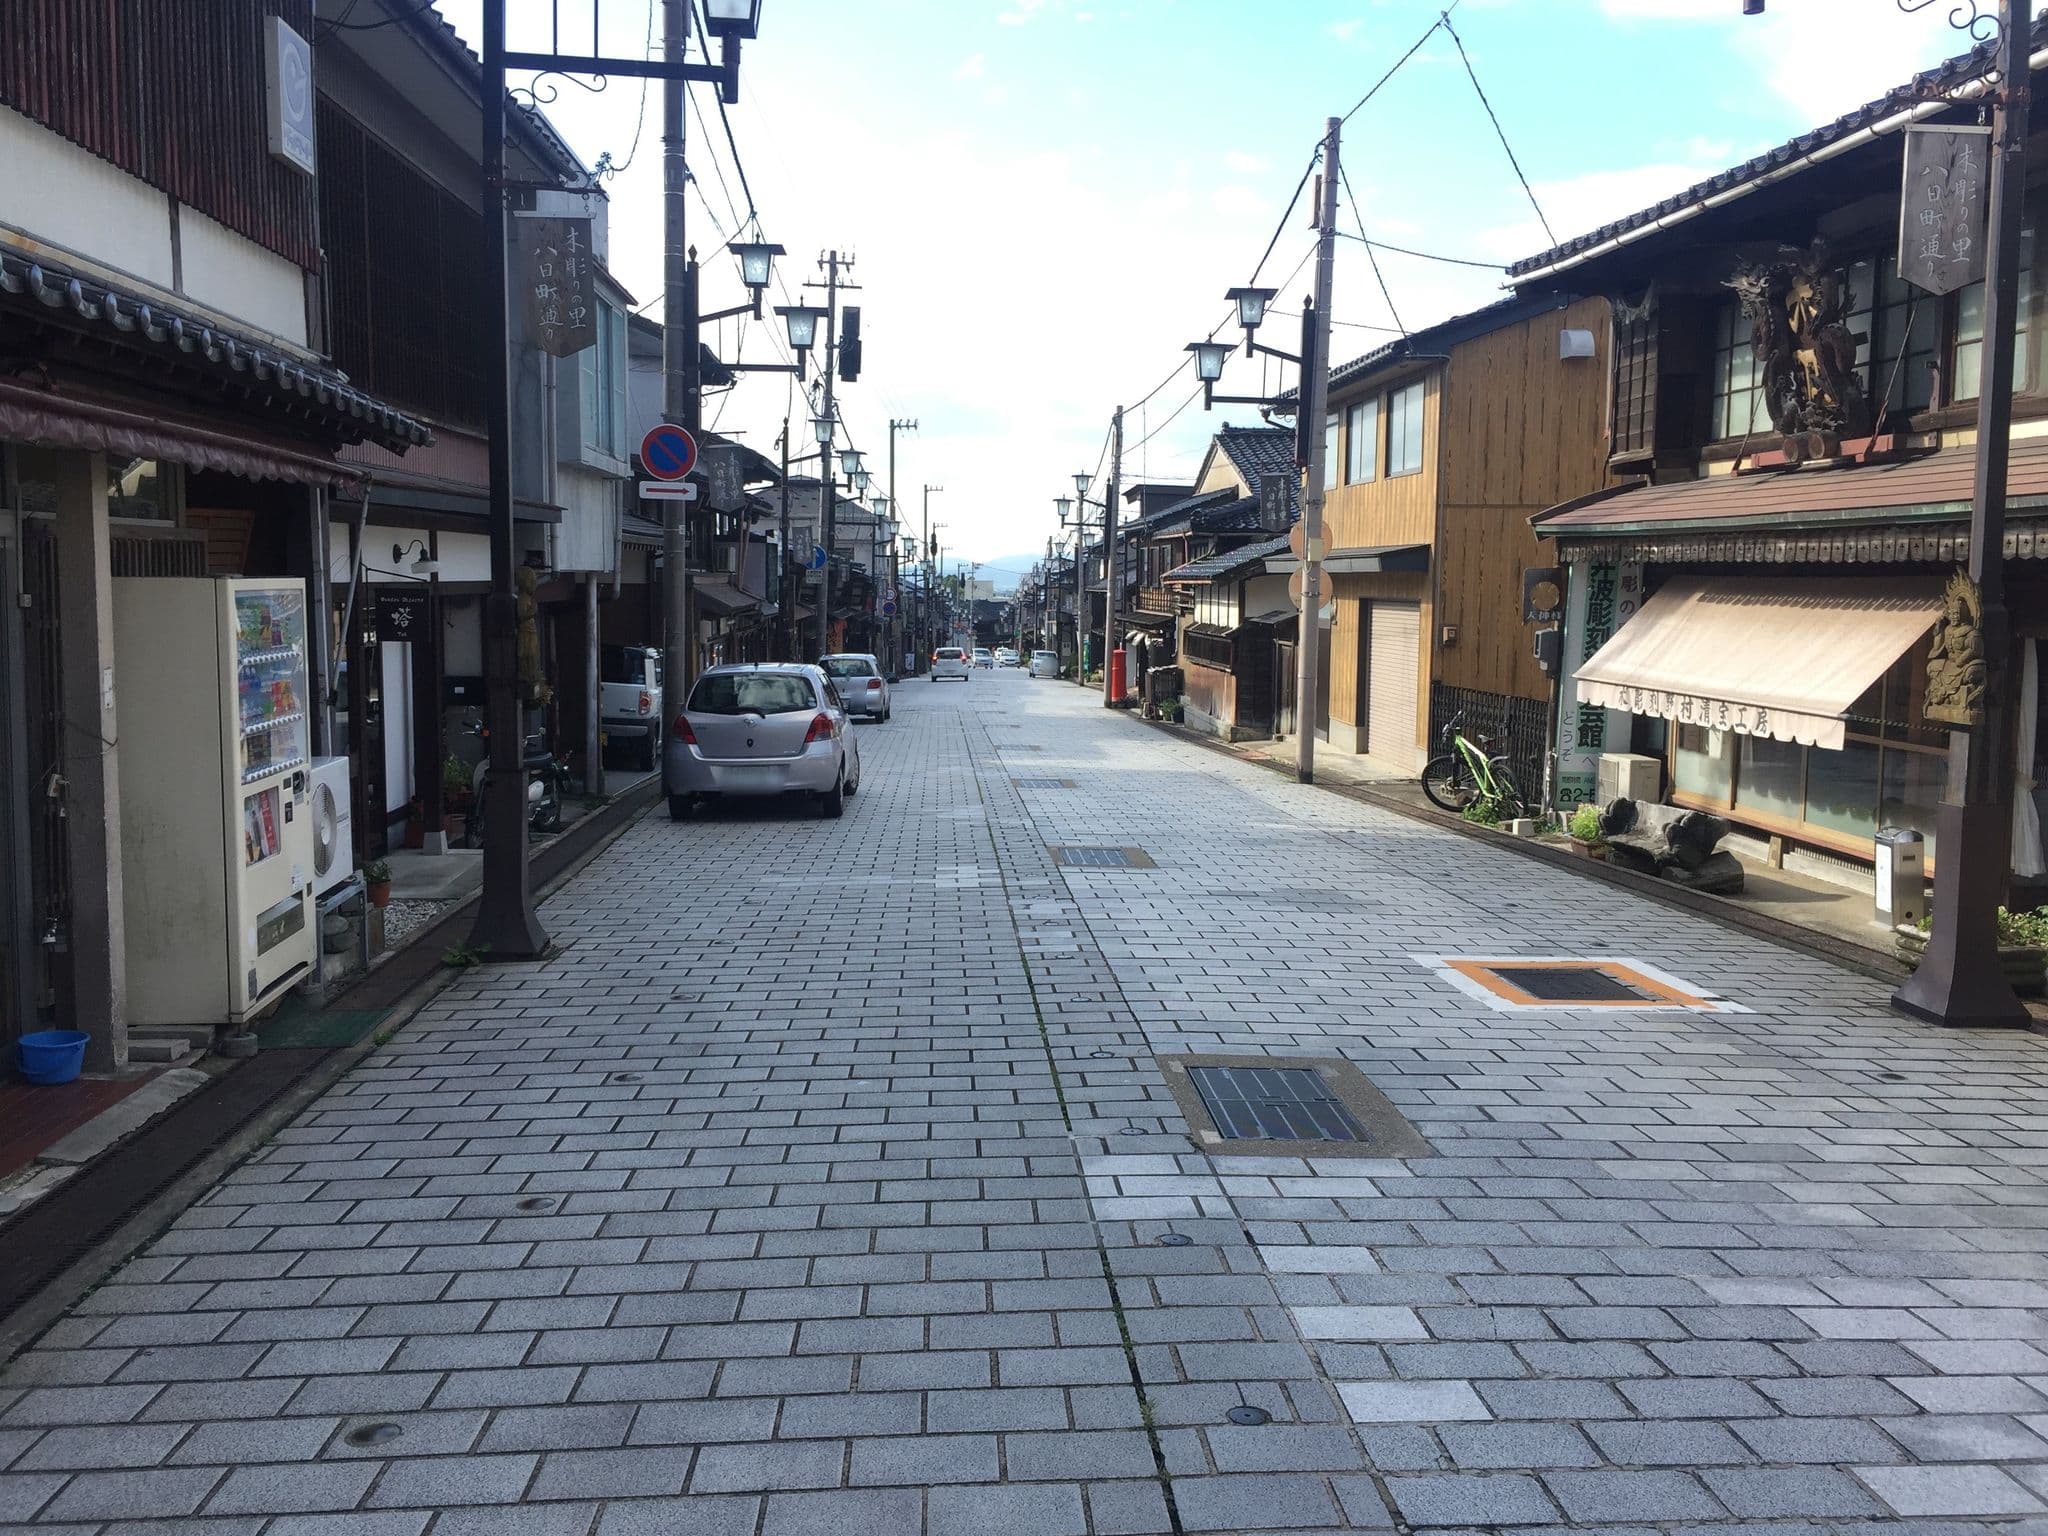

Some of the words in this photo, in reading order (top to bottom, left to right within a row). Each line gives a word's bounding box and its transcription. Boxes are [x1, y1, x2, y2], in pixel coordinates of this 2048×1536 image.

[1919, 165, 1949, 277] 八日町通り
[1951, 143, 1978, 263] 木彫りの里
[533, 246, 564, 340] 八日町通り
[564, 226, 586, 329] 木彫りの里
[391, 607, 413, 628] 塔
[1561, 711, 1575, 762] どうぞ
